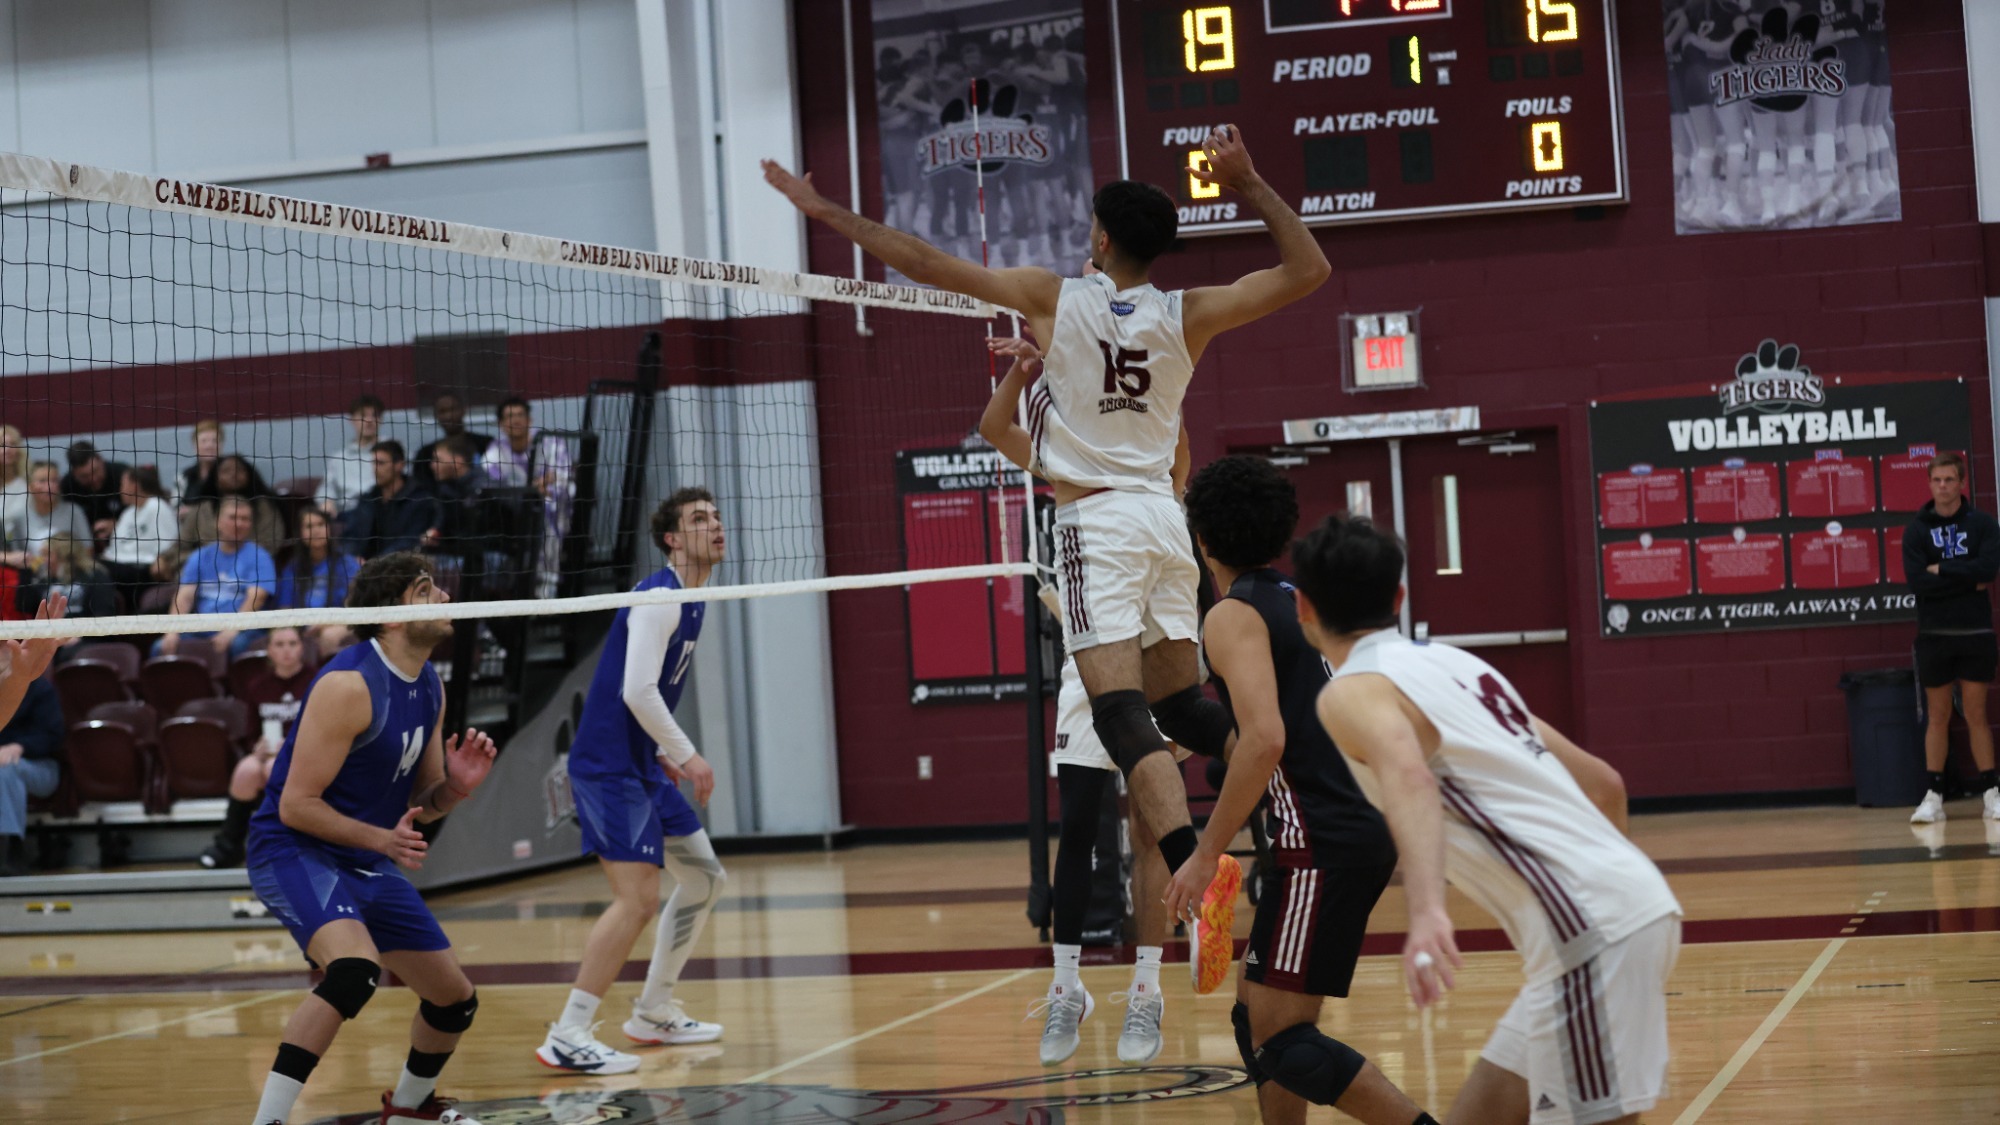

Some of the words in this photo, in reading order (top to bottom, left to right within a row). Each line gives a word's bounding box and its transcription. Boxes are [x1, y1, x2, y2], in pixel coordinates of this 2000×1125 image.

[1526, 0, 1578, 43] 15
[1183, 6, 1235, 73] 19
[1747, 35, 1811, 64] Lady
[1273, 53, 1371, 82] PERIOD
[1409, 35, 1421, 84] 1
[1711, 60, 1845, 107] TIGERS
[1294, 107, 1439, 135] PLAYER-FOUL
[1505, 96, 1572, 118] FOULS
[921, 127, 1050, 172] TIGERS
[1532, 121, 1563, 172] 0
[1301, 191, 1375, 215] MATCH
[1506, 175, 1582, 199] POINTS
[155, 177, 332, 228] CAMPBELLSVILLE
[340, 205, 451, 245] VOLLEYBALL
[1177, 202, 1238, 224] OINTS
[1097, 338, 1152, 398] 15
[1365, 335, 1405, 370] EXIT
[1098, 398, 1148, 414] TIGERS
[1720, 375, 1825, 409] TIGERS
[1668, 407, 1897, 453] VOLLEYBALL
[1641, 606, 1697, 624] ONCE
[1699, 606, 1713, 620] A
[1717, 602, 1780, 619] TIGER,
[1784, 597, 1861, 615] ALWAYS
[1864, 597, 1878, 611] A
[1882, 594, 1917, 610] TIG
